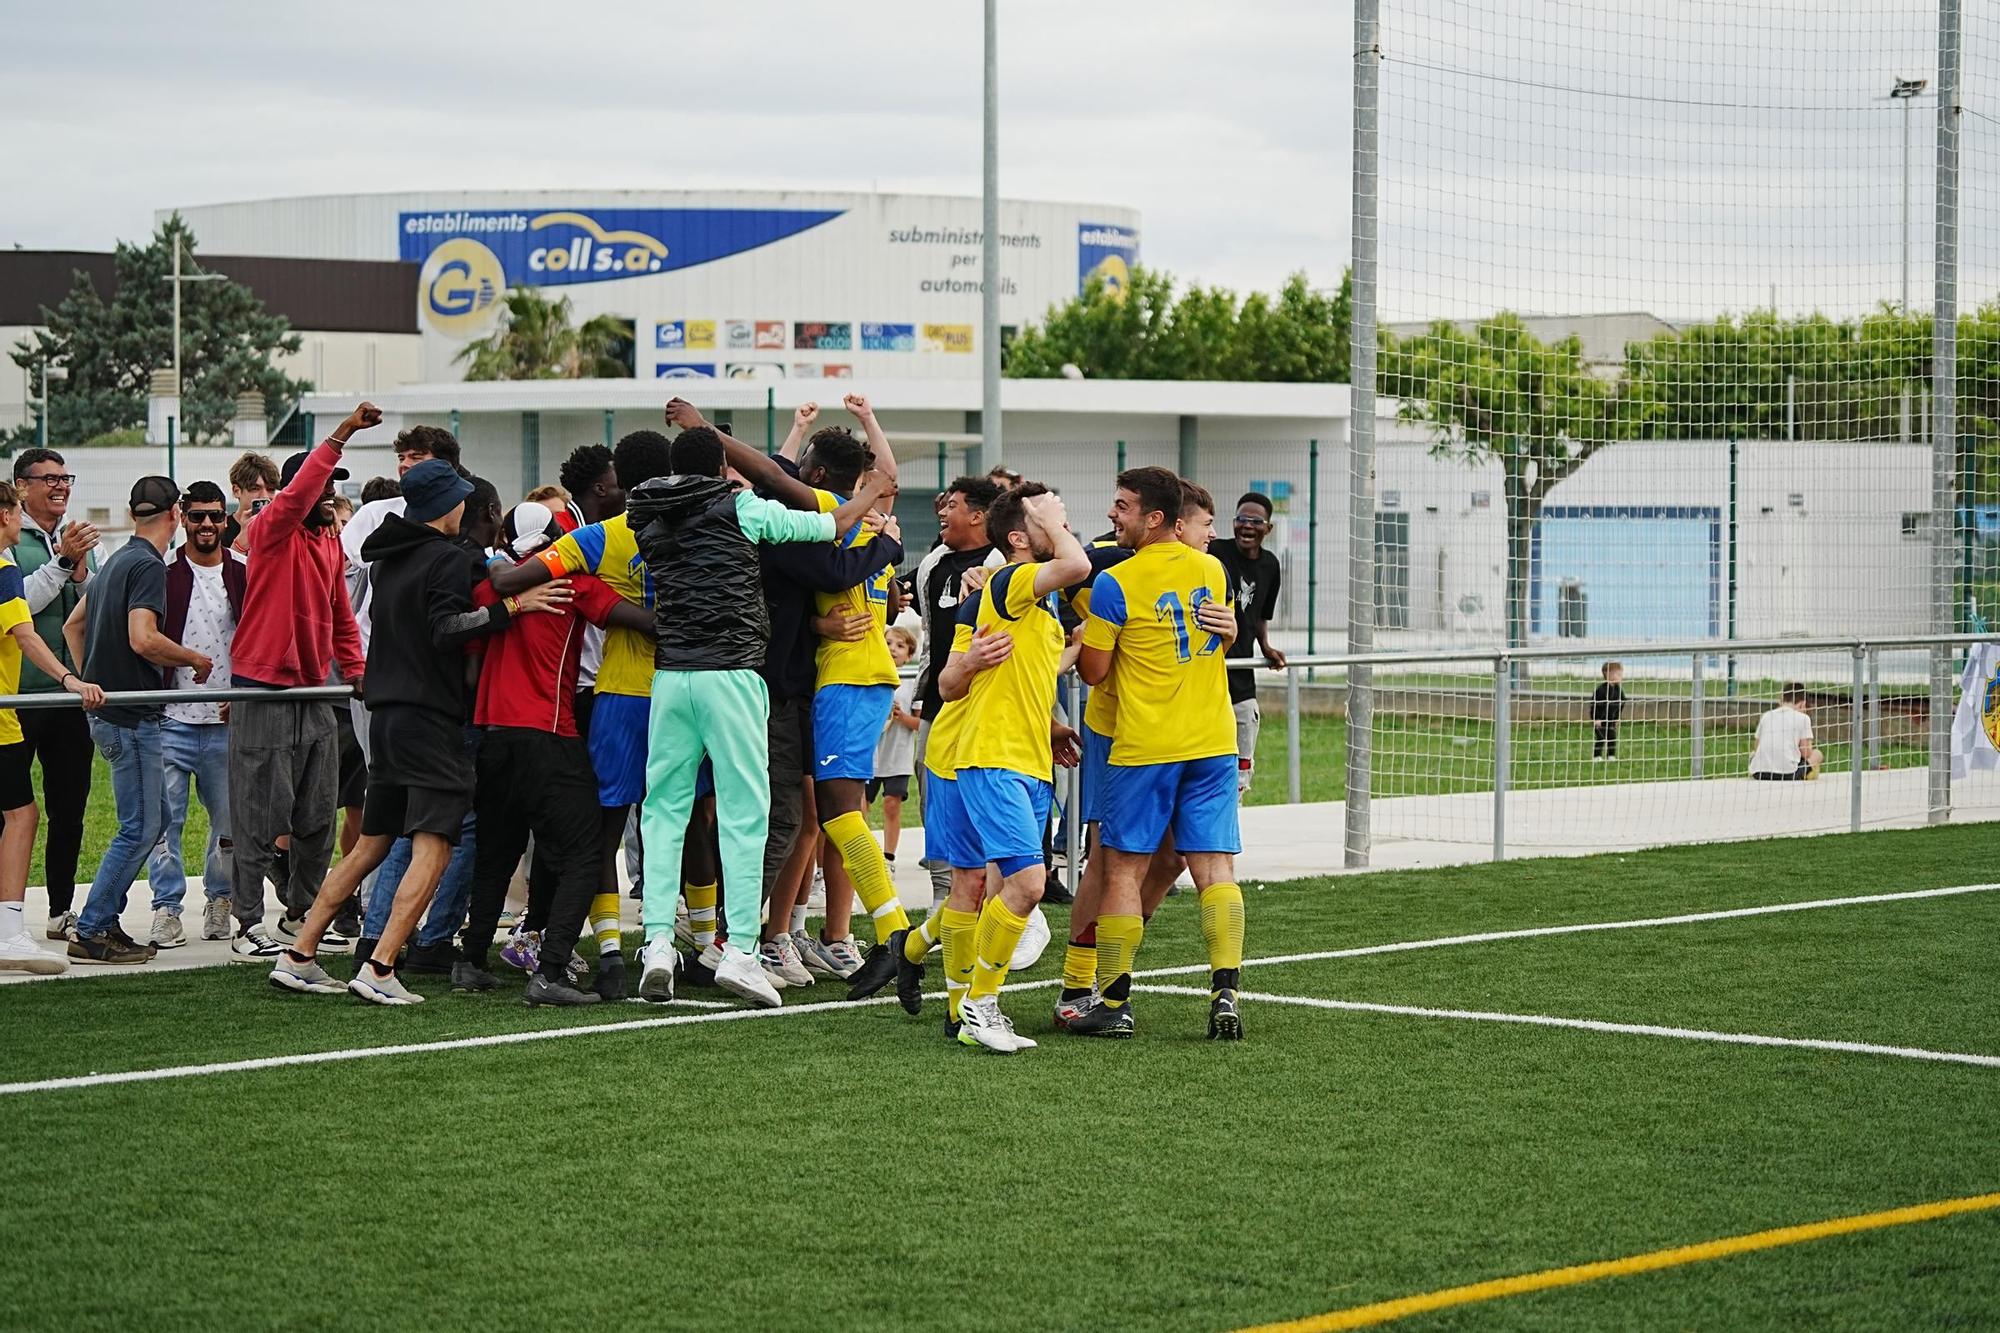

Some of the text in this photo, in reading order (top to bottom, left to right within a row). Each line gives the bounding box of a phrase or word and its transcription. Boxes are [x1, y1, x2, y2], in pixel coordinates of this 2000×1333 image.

[405, 213, 528, 233] establiments
[889, 226, 1041, 249] subministrments
[529, 237, 662, 272] coll s.a.
[951, 254, 976, 268] per
